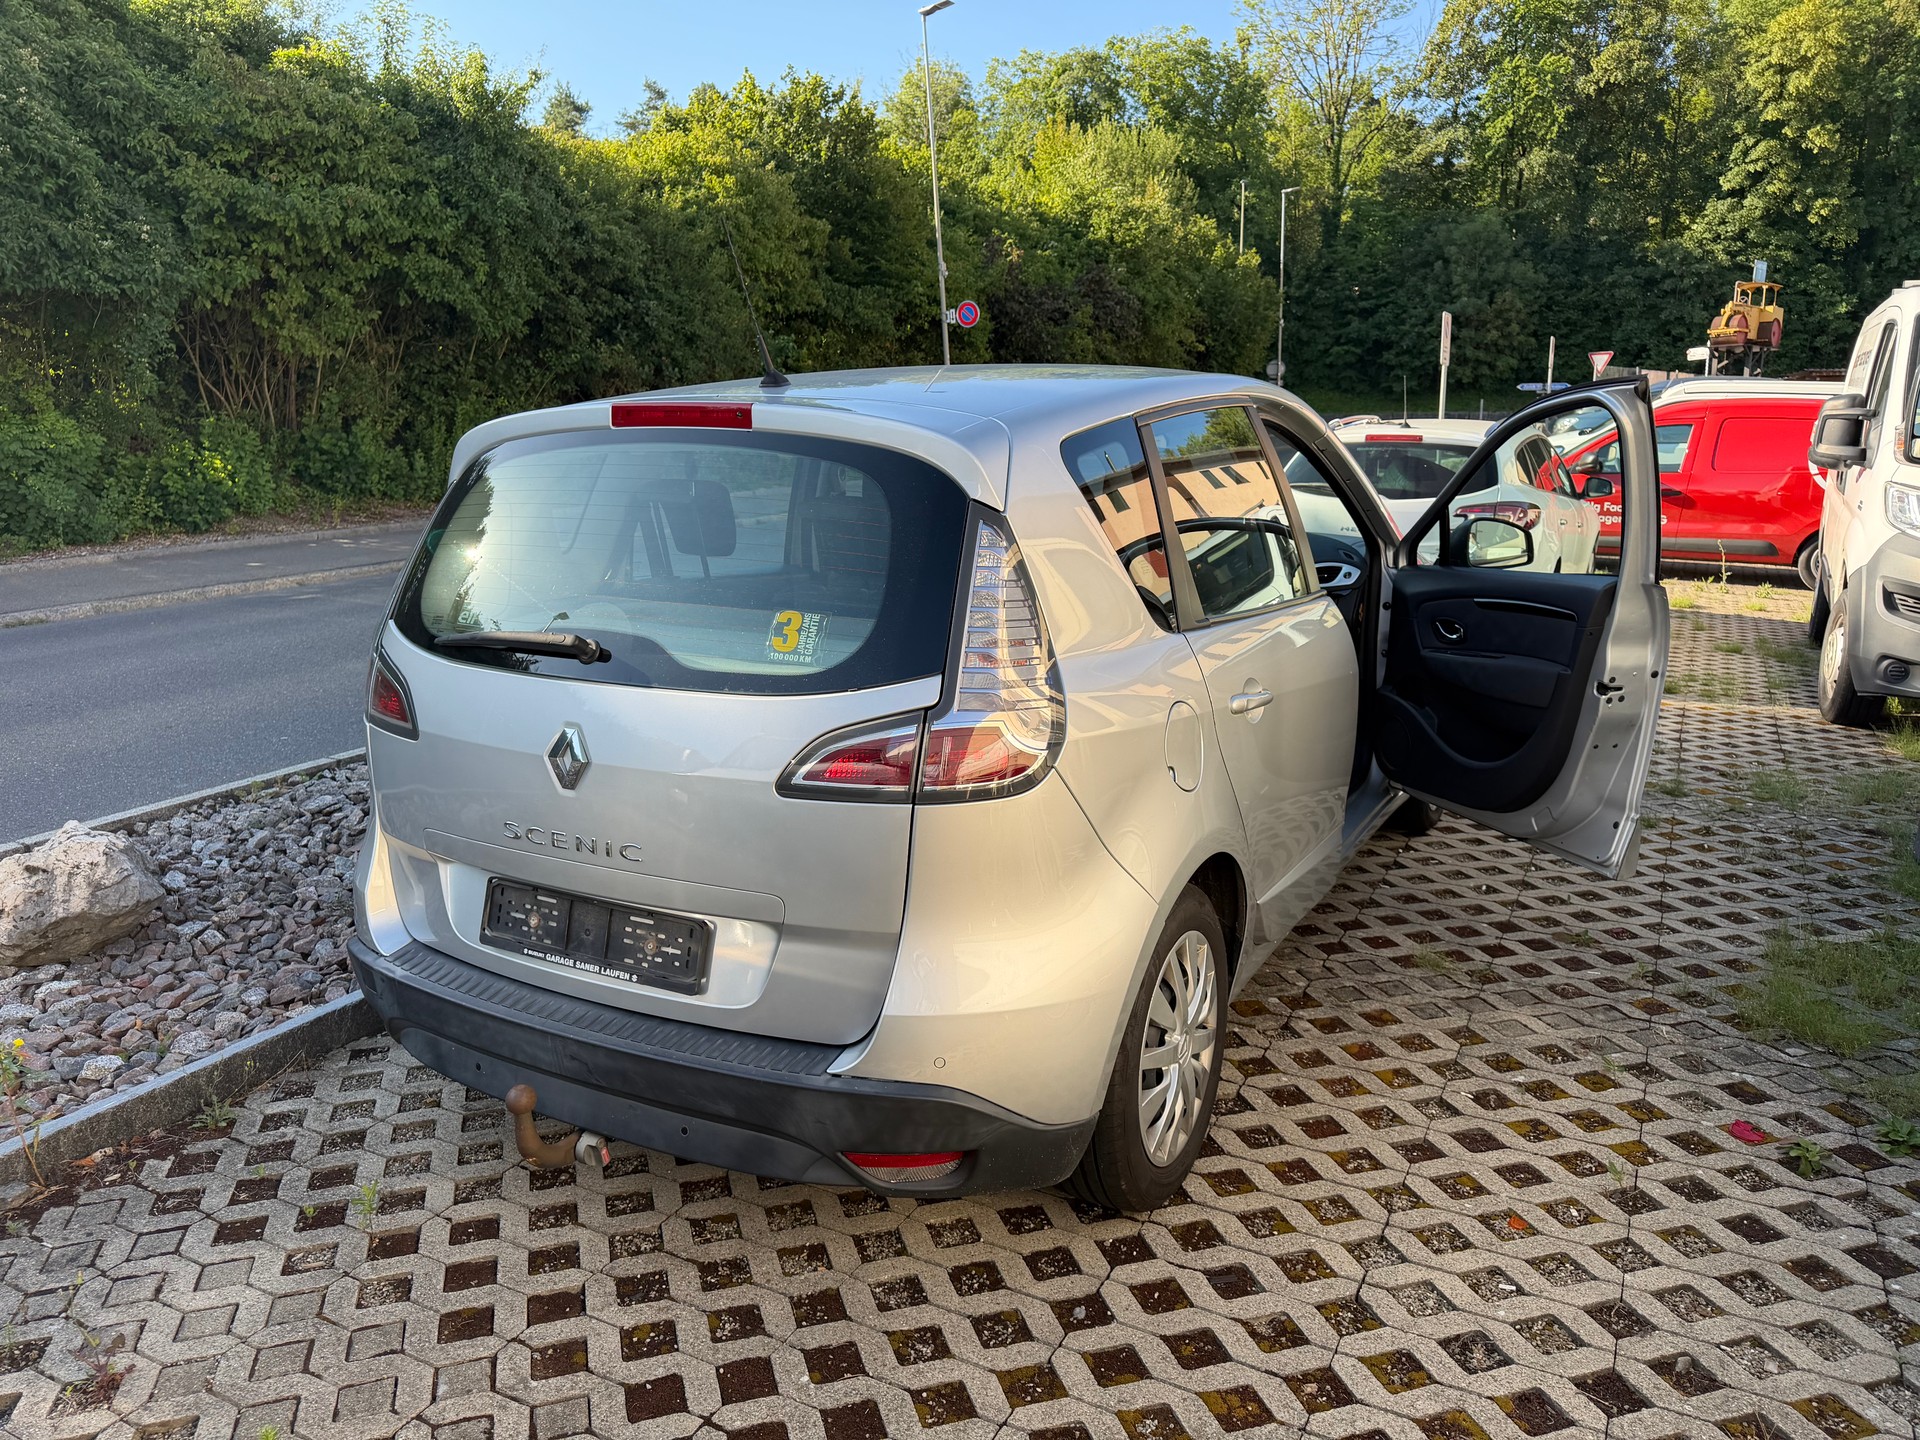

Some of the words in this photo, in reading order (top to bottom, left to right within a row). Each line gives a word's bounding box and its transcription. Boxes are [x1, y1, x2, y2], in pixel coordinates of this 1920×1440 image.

[1599, 515, 1622, 525] age
[1603, 501, 1622, 513] Fac
[772, 610, 803, 653] 3
[797, 612, 812, 654] JAHRE/ANS
[804, 613, 821, 655] GARANTIE
[799, 655, 812, 663] KM
[503, 820, 642, 862] SCENIC
[545, 953, 574, 967] GARAGE
[601, 967, 630, 980] LAUFEN
